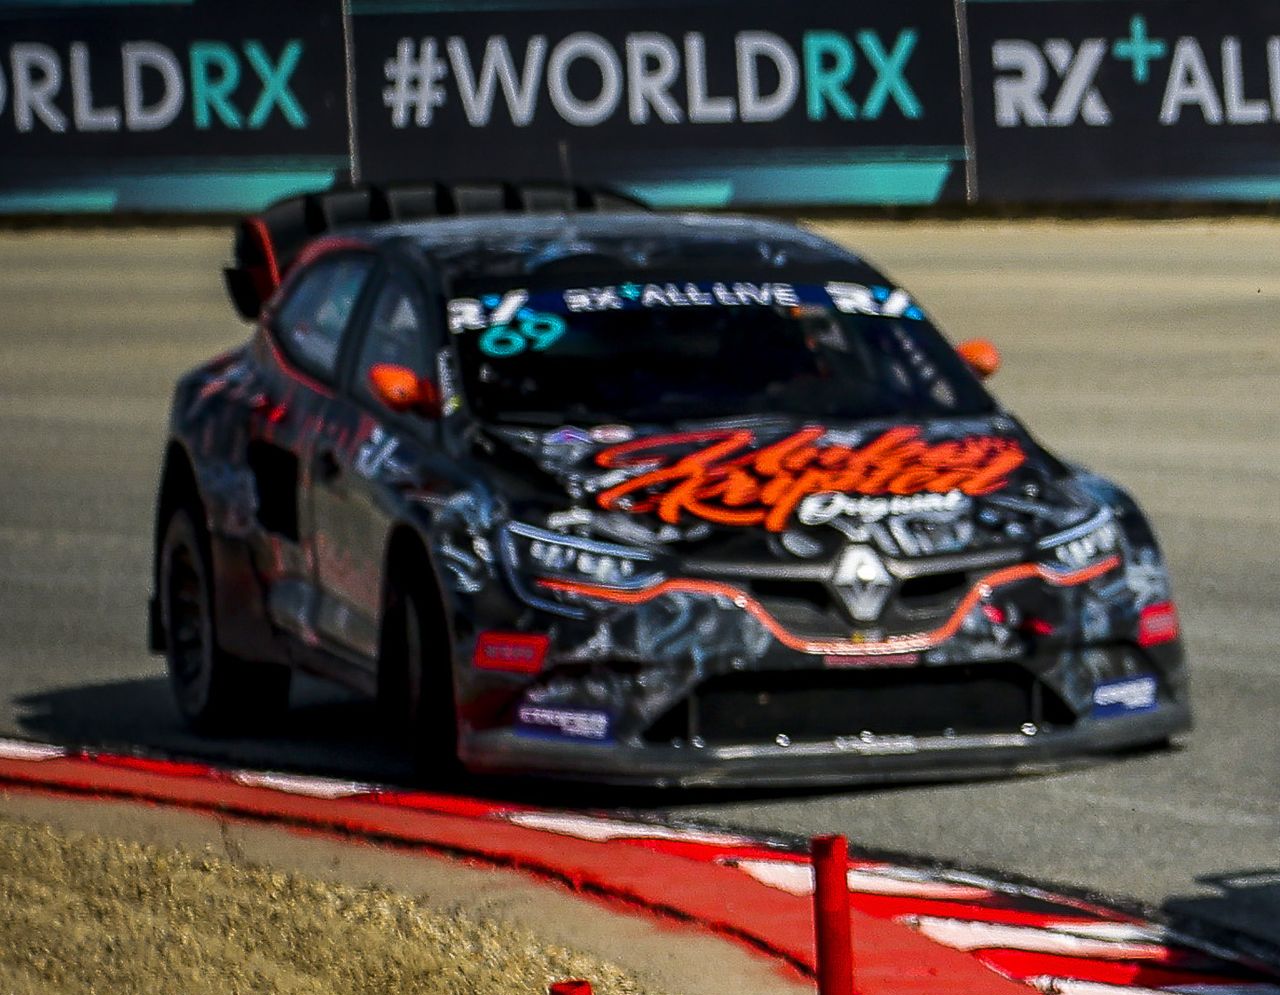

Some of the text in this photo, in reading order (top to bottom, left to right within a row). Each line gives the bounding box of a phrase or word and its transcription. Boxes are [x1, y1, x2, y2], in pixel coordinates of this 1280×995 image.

[0, 41, 307, 131] RLDRX
[382, 29, 924, 127] #WORLDRX
[712, 282, 800, 307] LIVE
[478, 312, 568, 357] 69
